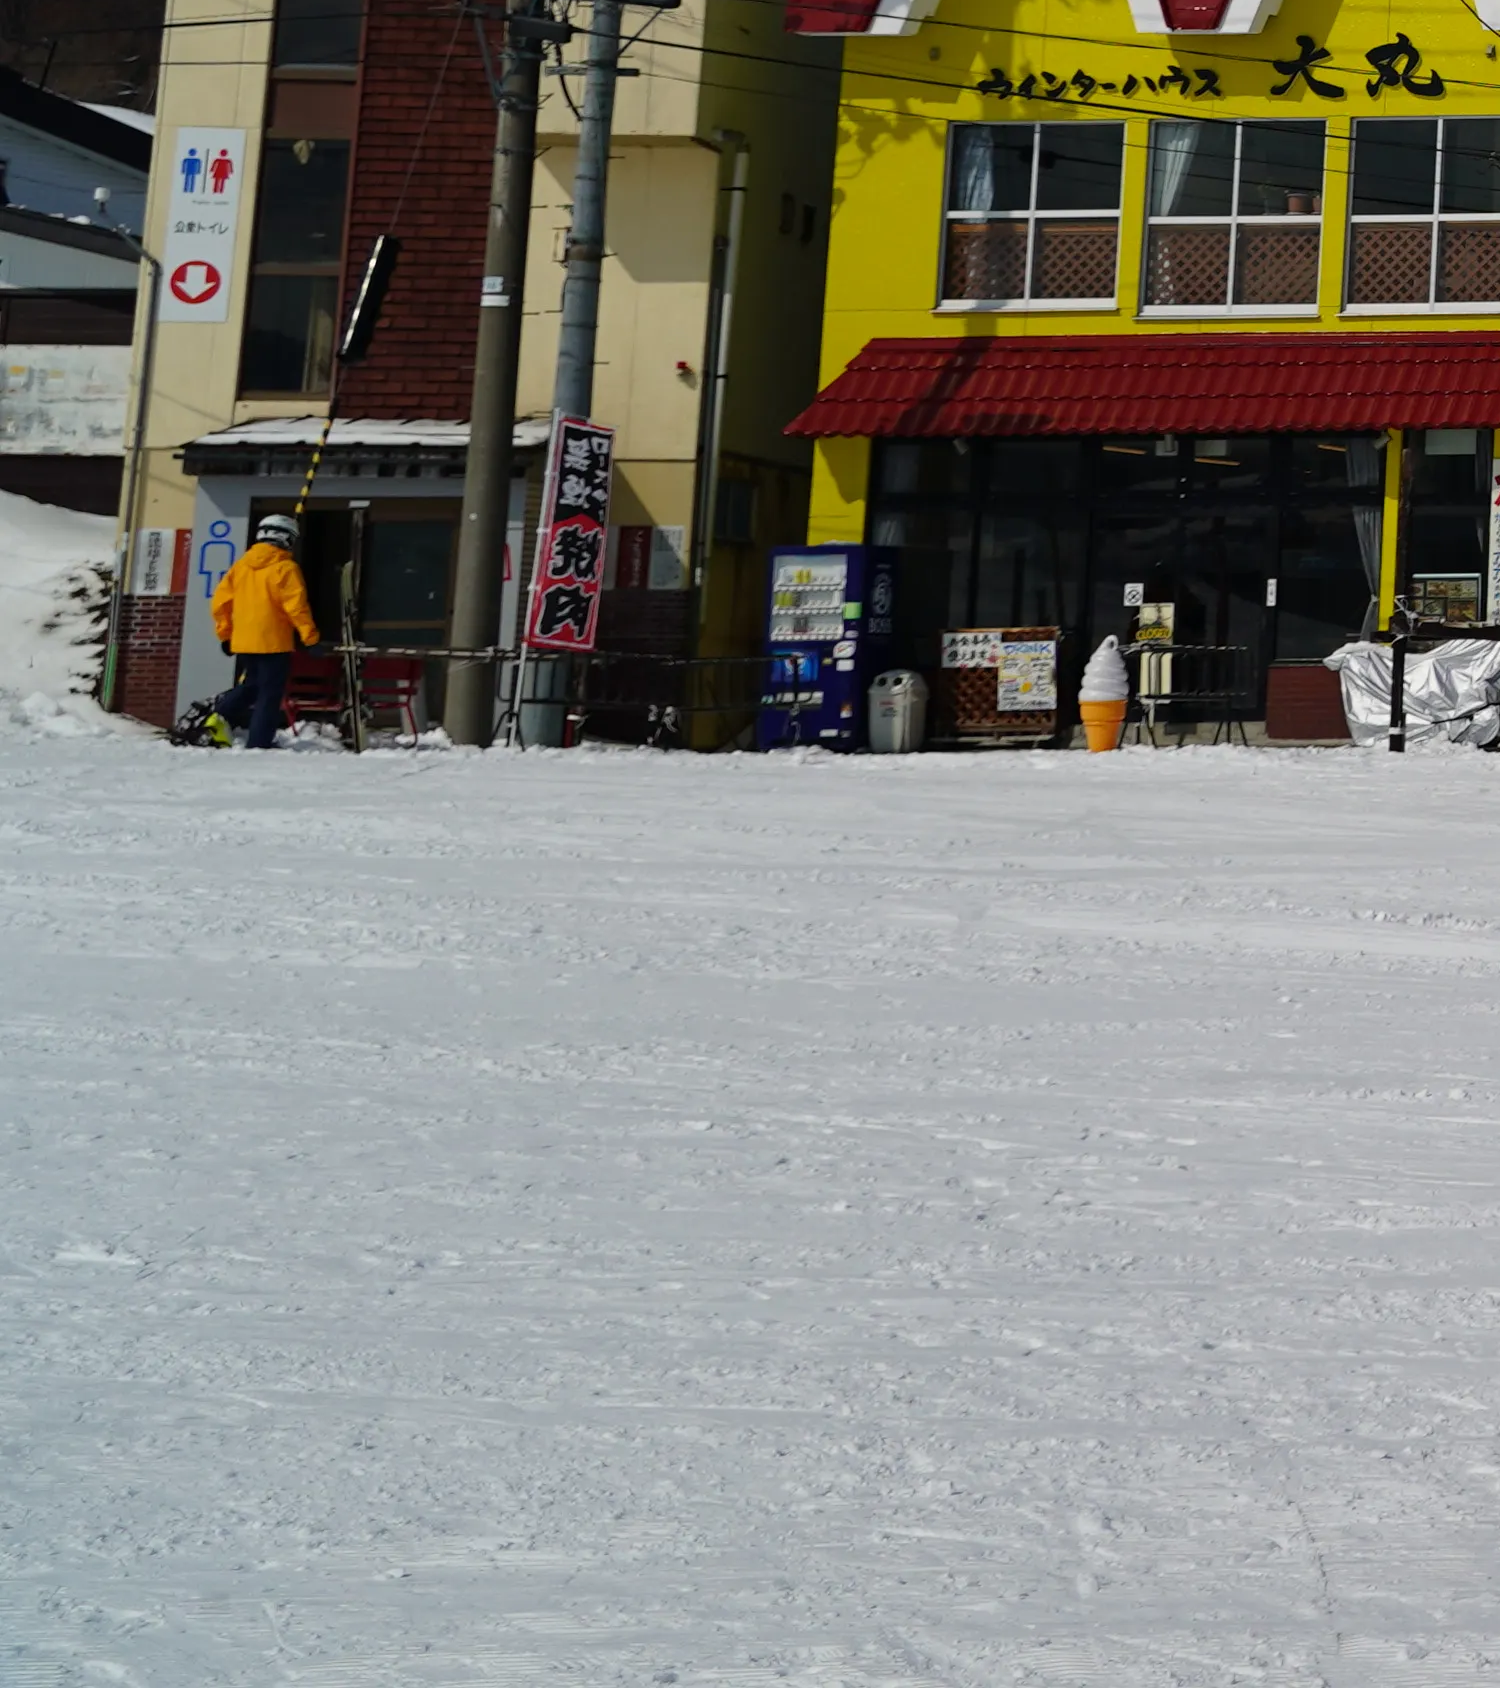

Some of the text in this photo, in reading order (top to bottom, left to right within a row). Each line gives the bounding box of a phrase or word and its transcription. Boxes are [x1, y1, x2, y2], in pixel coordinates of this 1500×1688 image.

[1271, 32, 1444, 100] 大丸
[174, 220, 229, 235] 公衆トイレ
